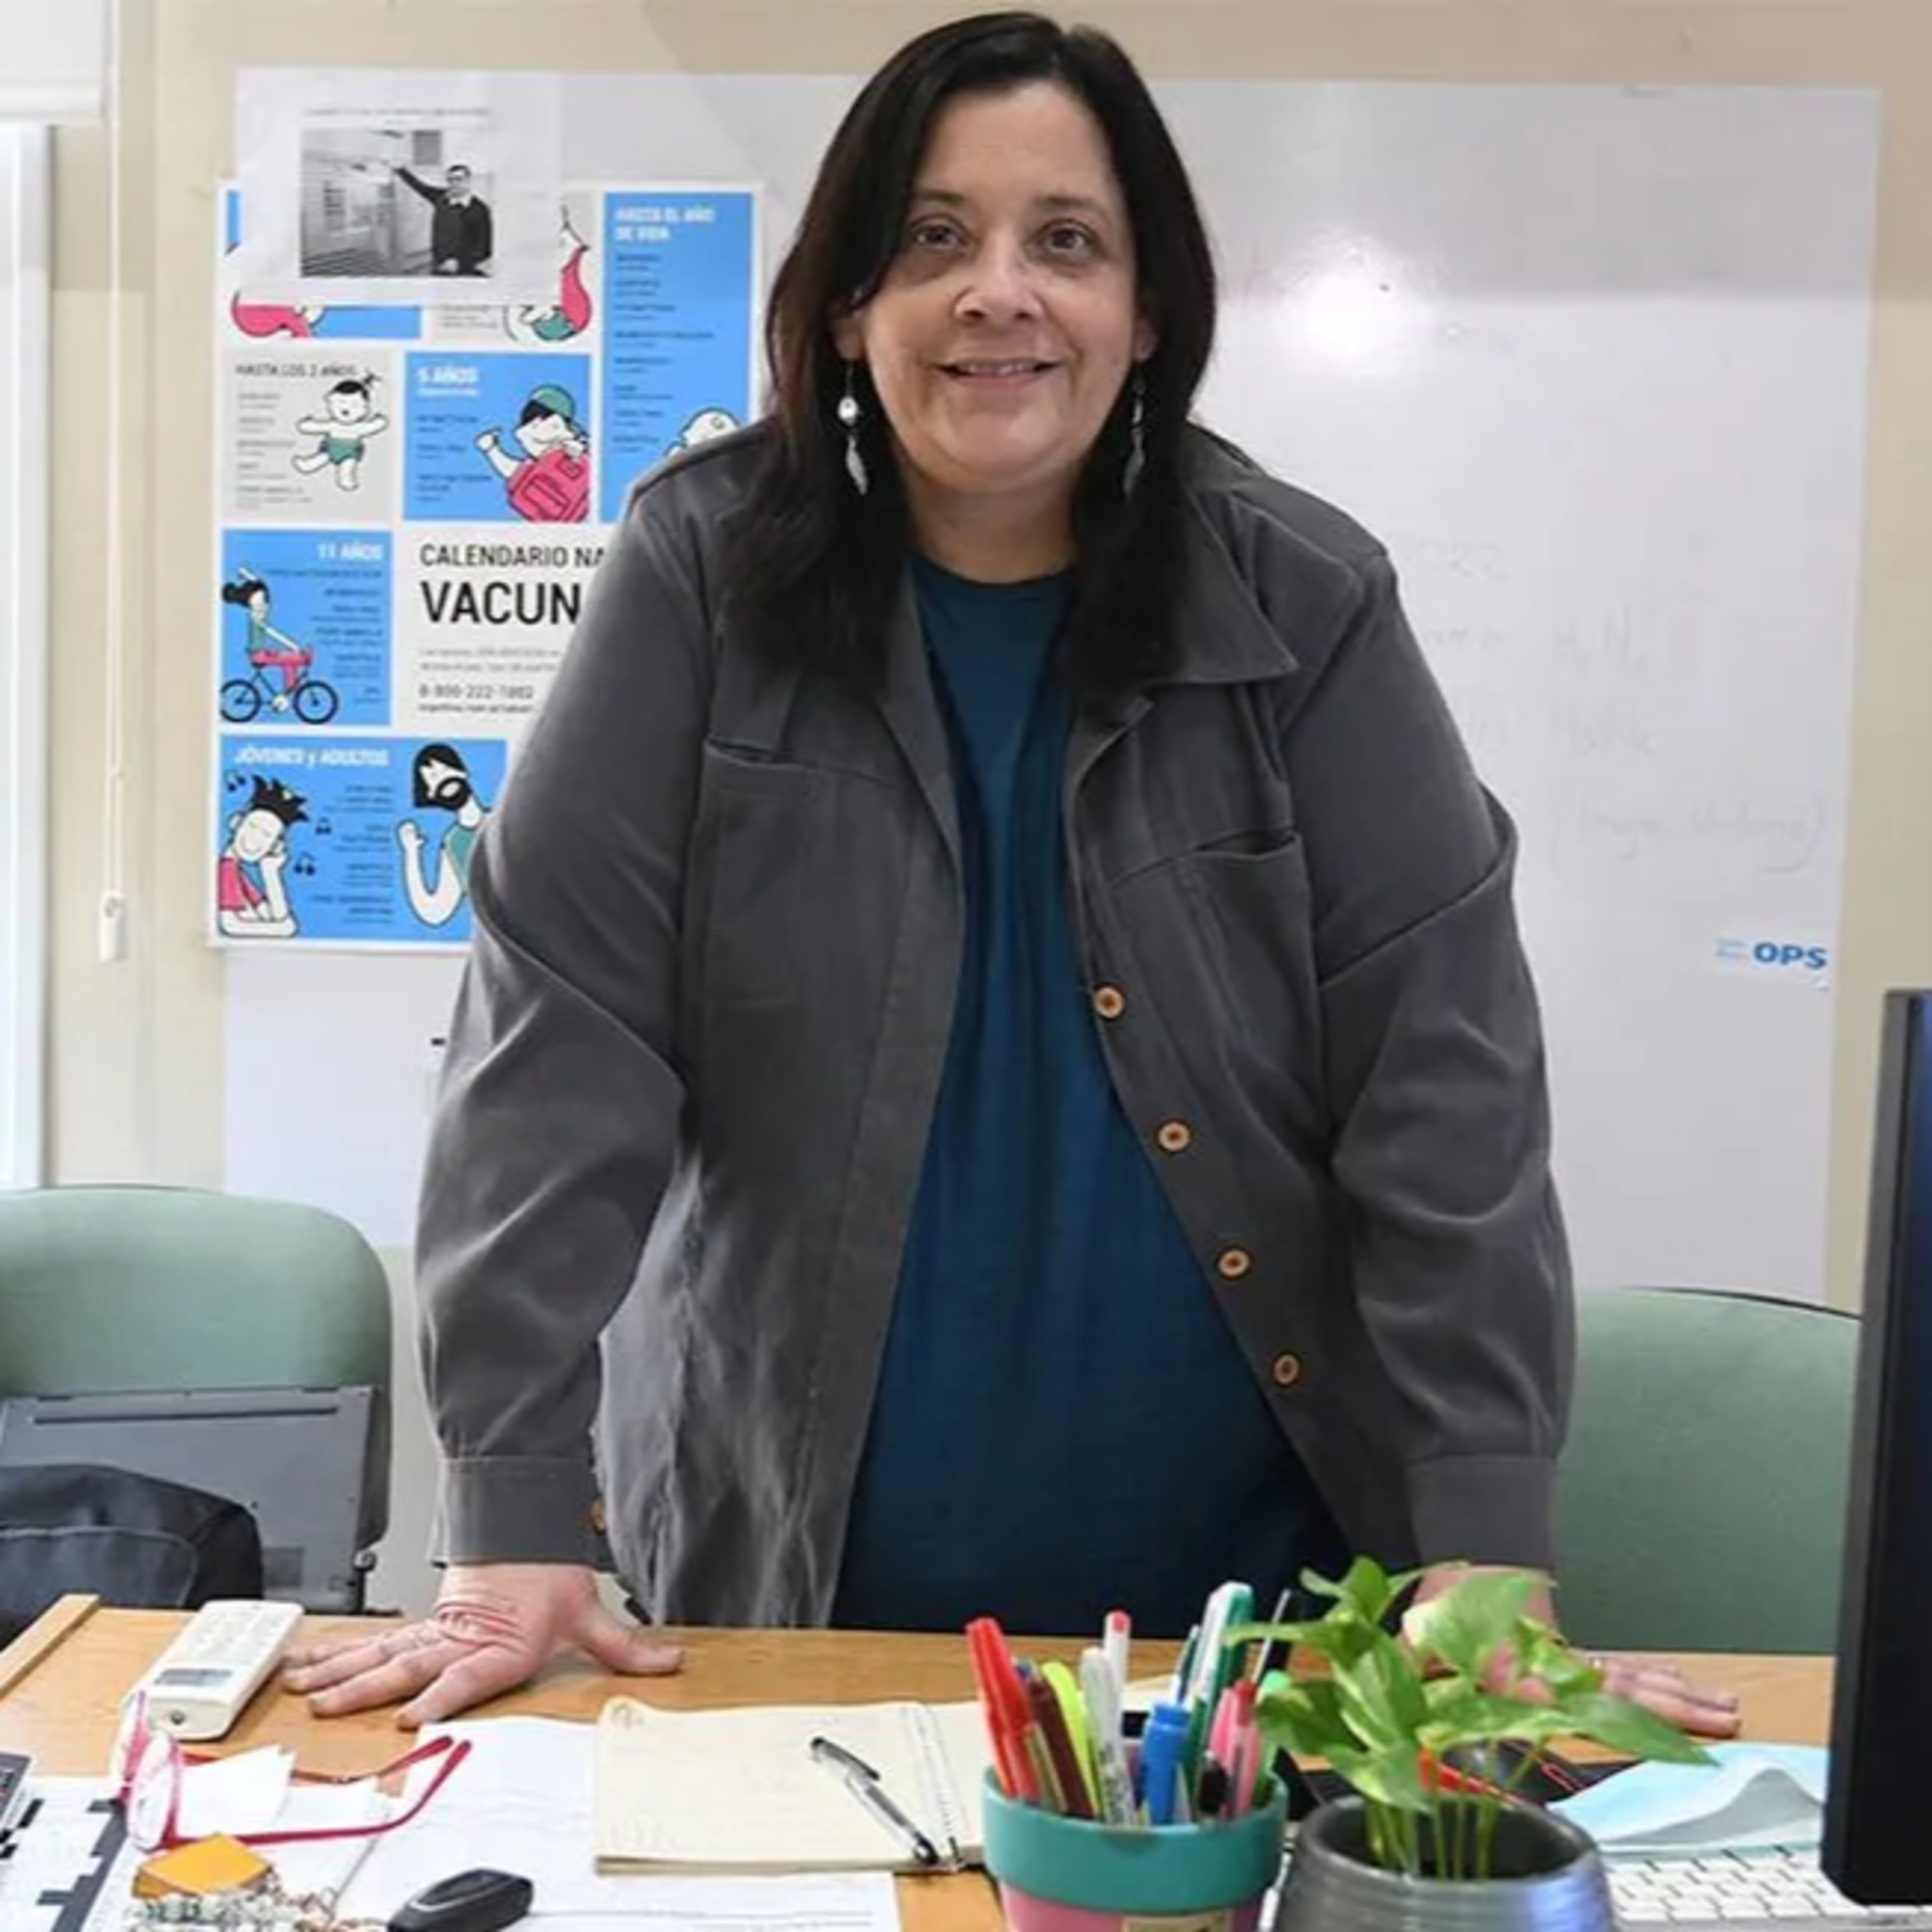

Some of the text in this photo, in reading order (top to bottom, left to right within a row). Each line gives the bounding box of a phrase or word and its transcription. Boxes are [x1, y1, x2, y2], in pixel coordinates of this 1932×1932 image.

[433, 364, 478, 384] AÑOS
[317, 540, 383, 561] 11 AÑOS
[420, 544, 568, 566] CALENDARIO
[421, 581, 580, 623] VACUN
[1754, 942, 1826, 970] OPS
